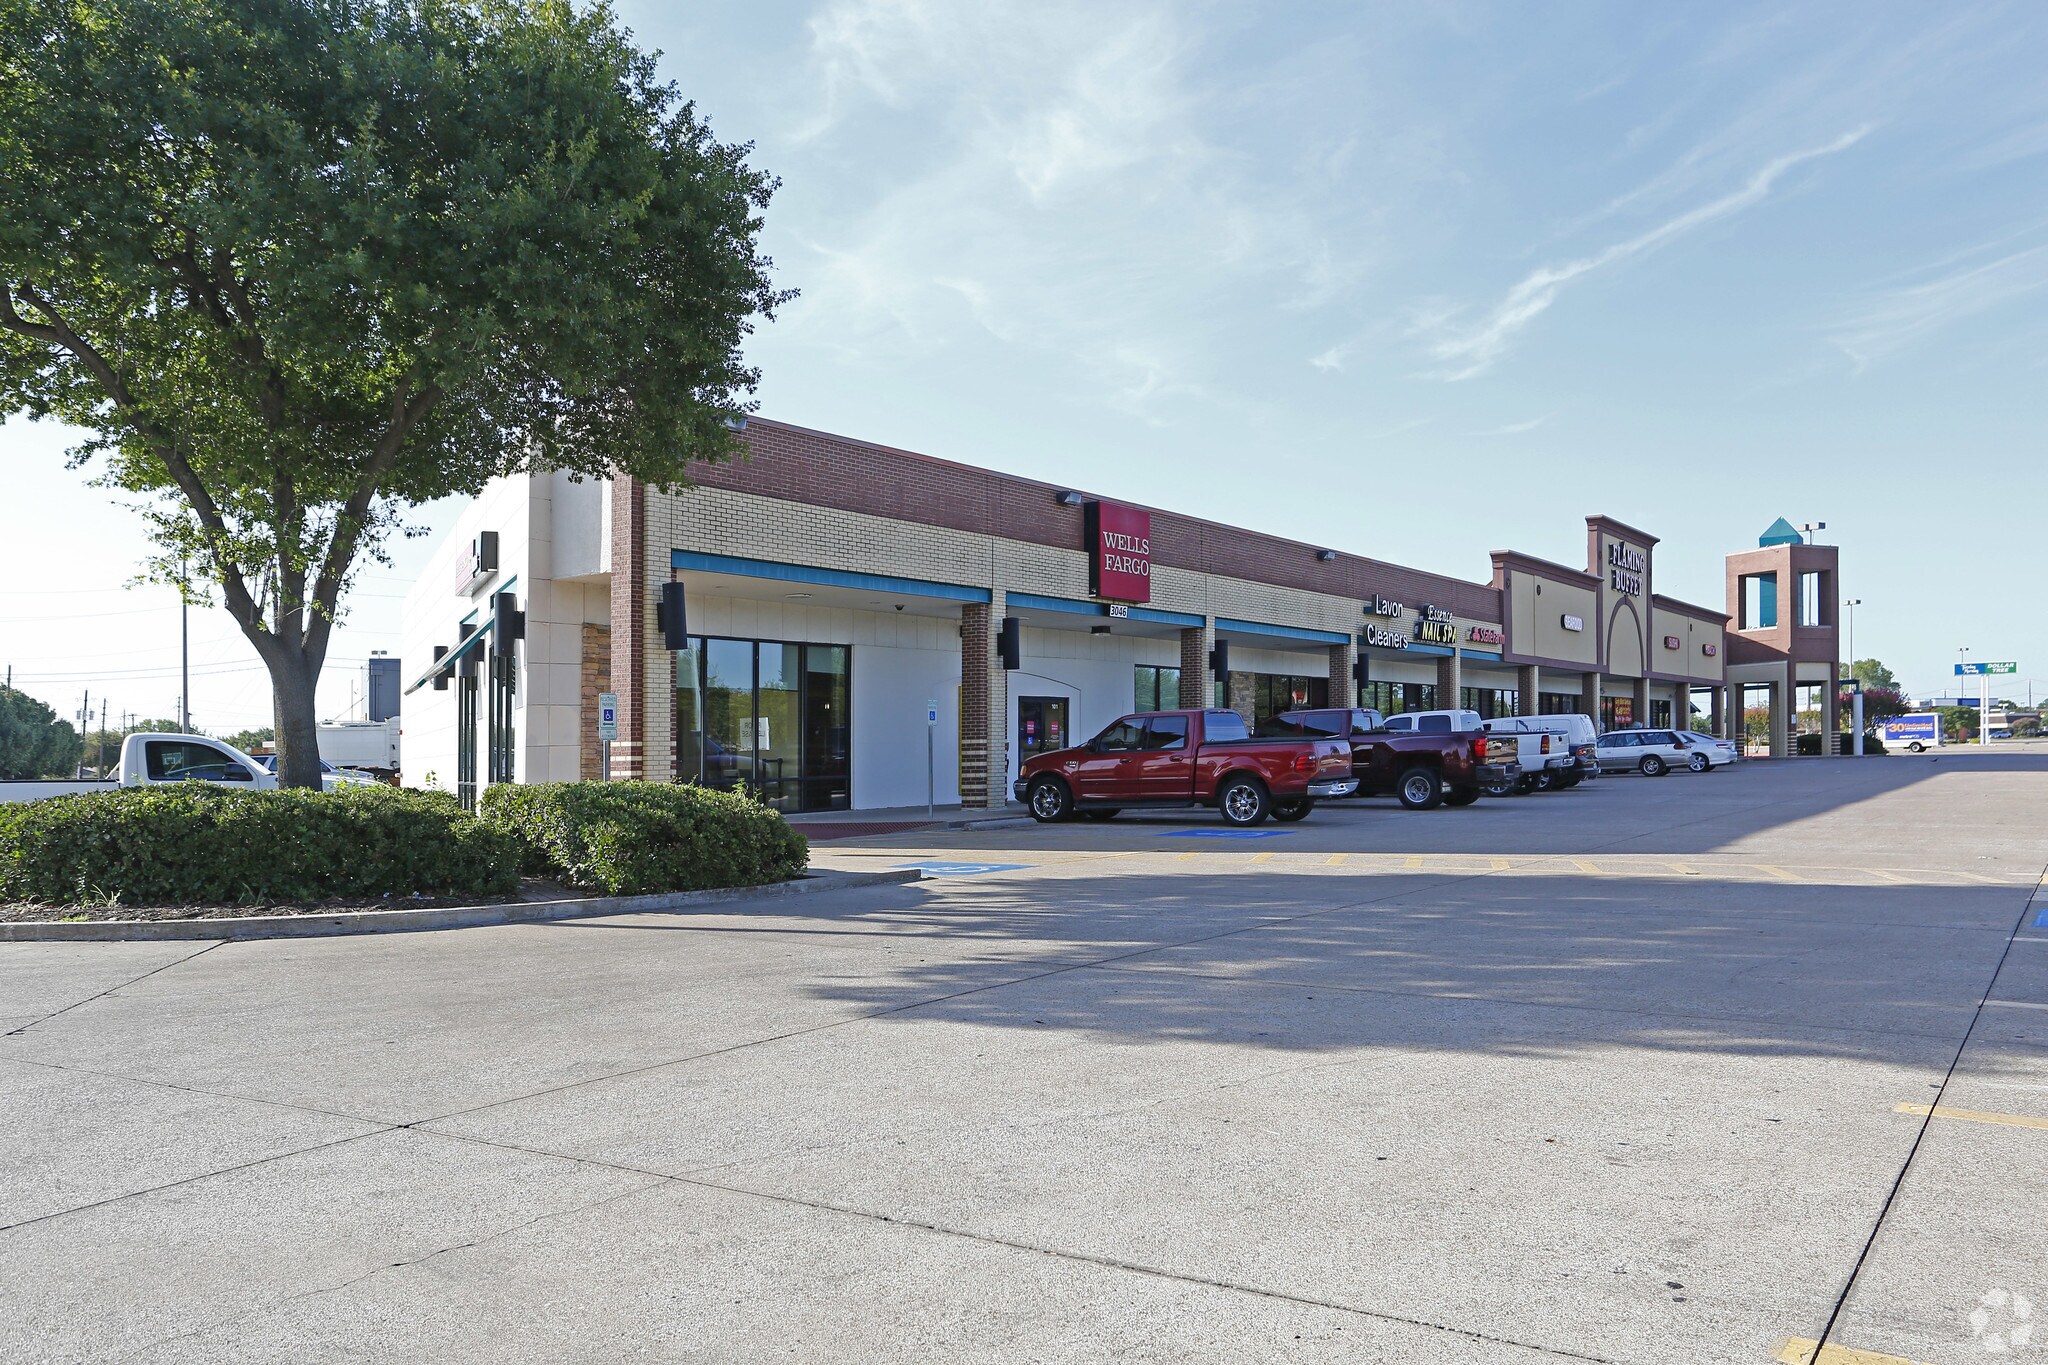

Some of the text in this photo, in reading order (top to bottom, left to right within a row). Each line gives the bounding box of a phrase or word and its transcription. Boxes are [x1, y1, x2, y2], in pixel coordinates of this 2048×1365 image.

[1103, 531, 1149, 555] WELLS
[1104, 553, 1149, 576] FARGO
[1615, 569, 1643, 597] BUFFET
[1111, 606, 1126, 616] 3046
[1376, 594, 1403, 618] Lavon
[1428, 604, 1453, 623] Essence
[1367, 624, 1409, 649] Cleaners
[1422, 621, 1457, 643] NAIL SPA
